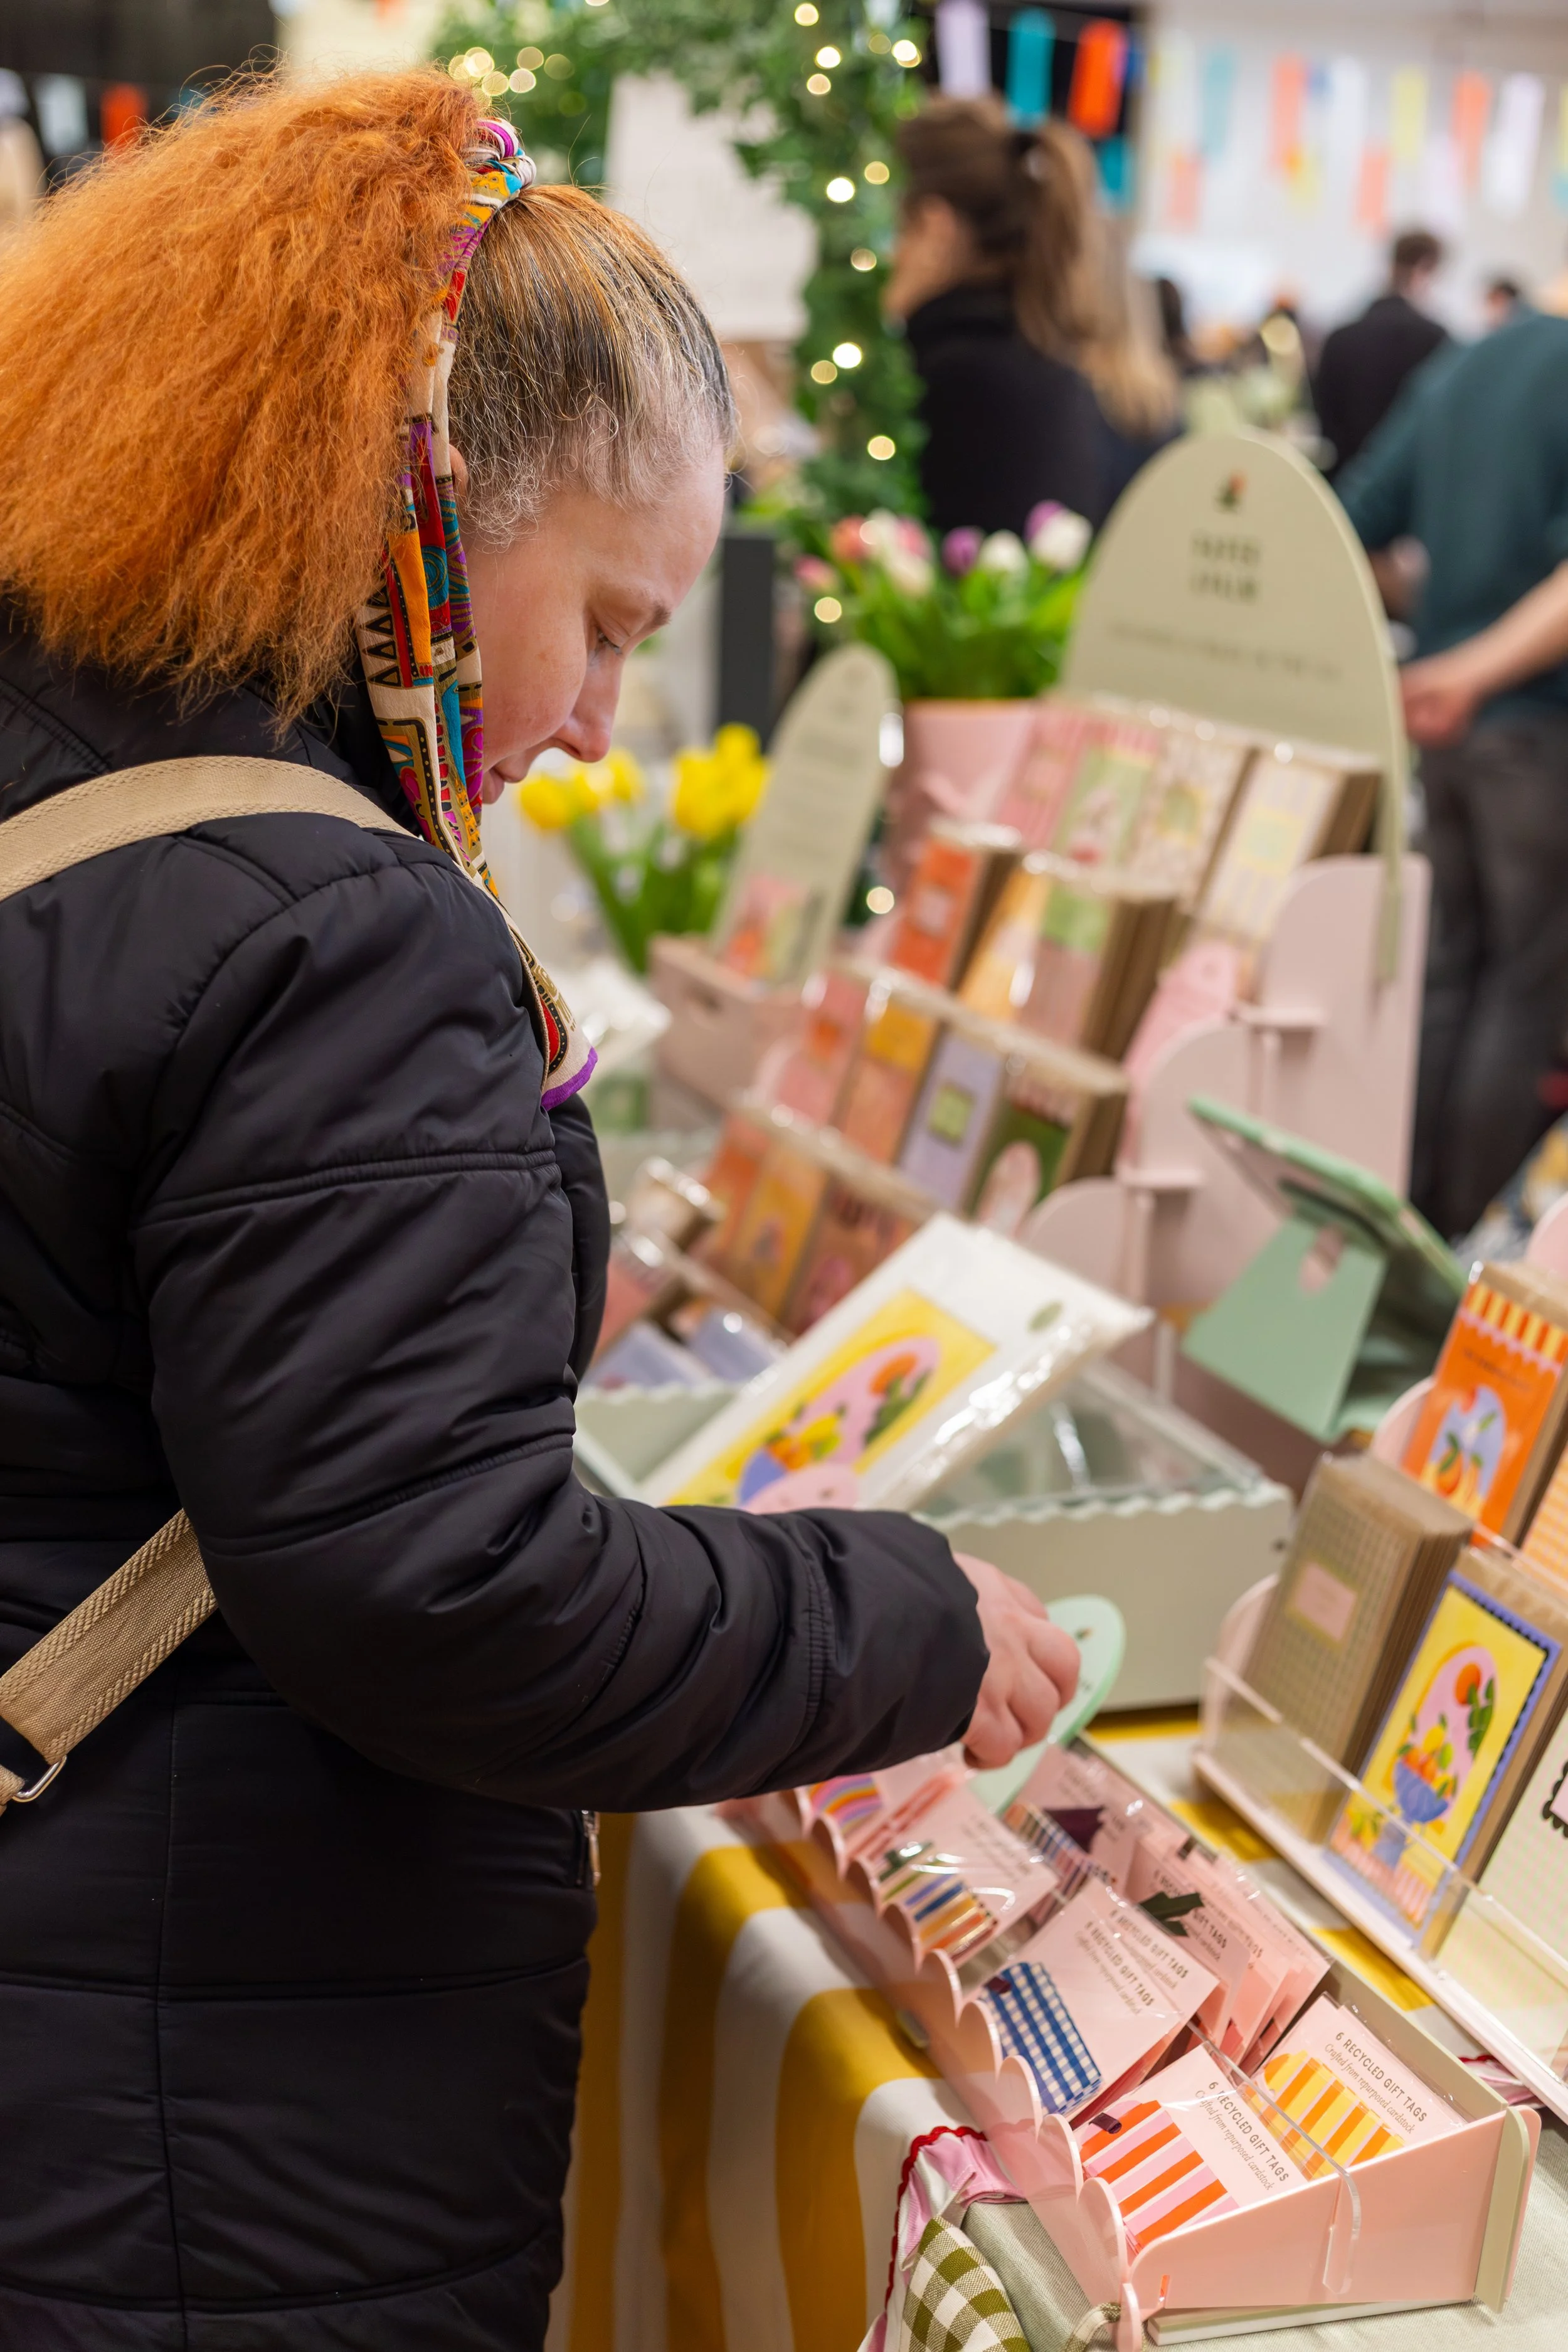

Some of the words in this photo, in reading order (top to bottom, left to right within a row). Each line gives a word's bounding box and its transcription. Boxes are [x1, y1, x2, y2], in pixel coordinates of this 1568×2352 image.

[1120, 1965, 1138, 1984] GIFT
[1134, 1983, 1155, 2006] TAGS
[1167, 1957, 1189, 1979] TAGS
[1325, 2043, 1348, 2067] Crafted
[1341, 2062, 1359, 2080] from
[1358, 2077, 1391, 2109] repurposed
[1387, 2107, 1416, 2134] cardstock
[1335, 2032, 1345, 2041] 6
[1343, 2039, 1385, 2080] RECYCLED
[1384, 2079, 1405, 2099] GIFT
[1402, 2096, 1427, 2122] TAGS
[1209, 2082, 1219, 2090] 6
[1249, 2134, 1270, 2155] GIFT
[1266, 2154, 1289, 2181] TAGS
[1212, 2114, 1227, 2130] from
[1223, 2128, 1254, 2161] repurposed
[1248, 2161, 1274, 2190] cardstock
